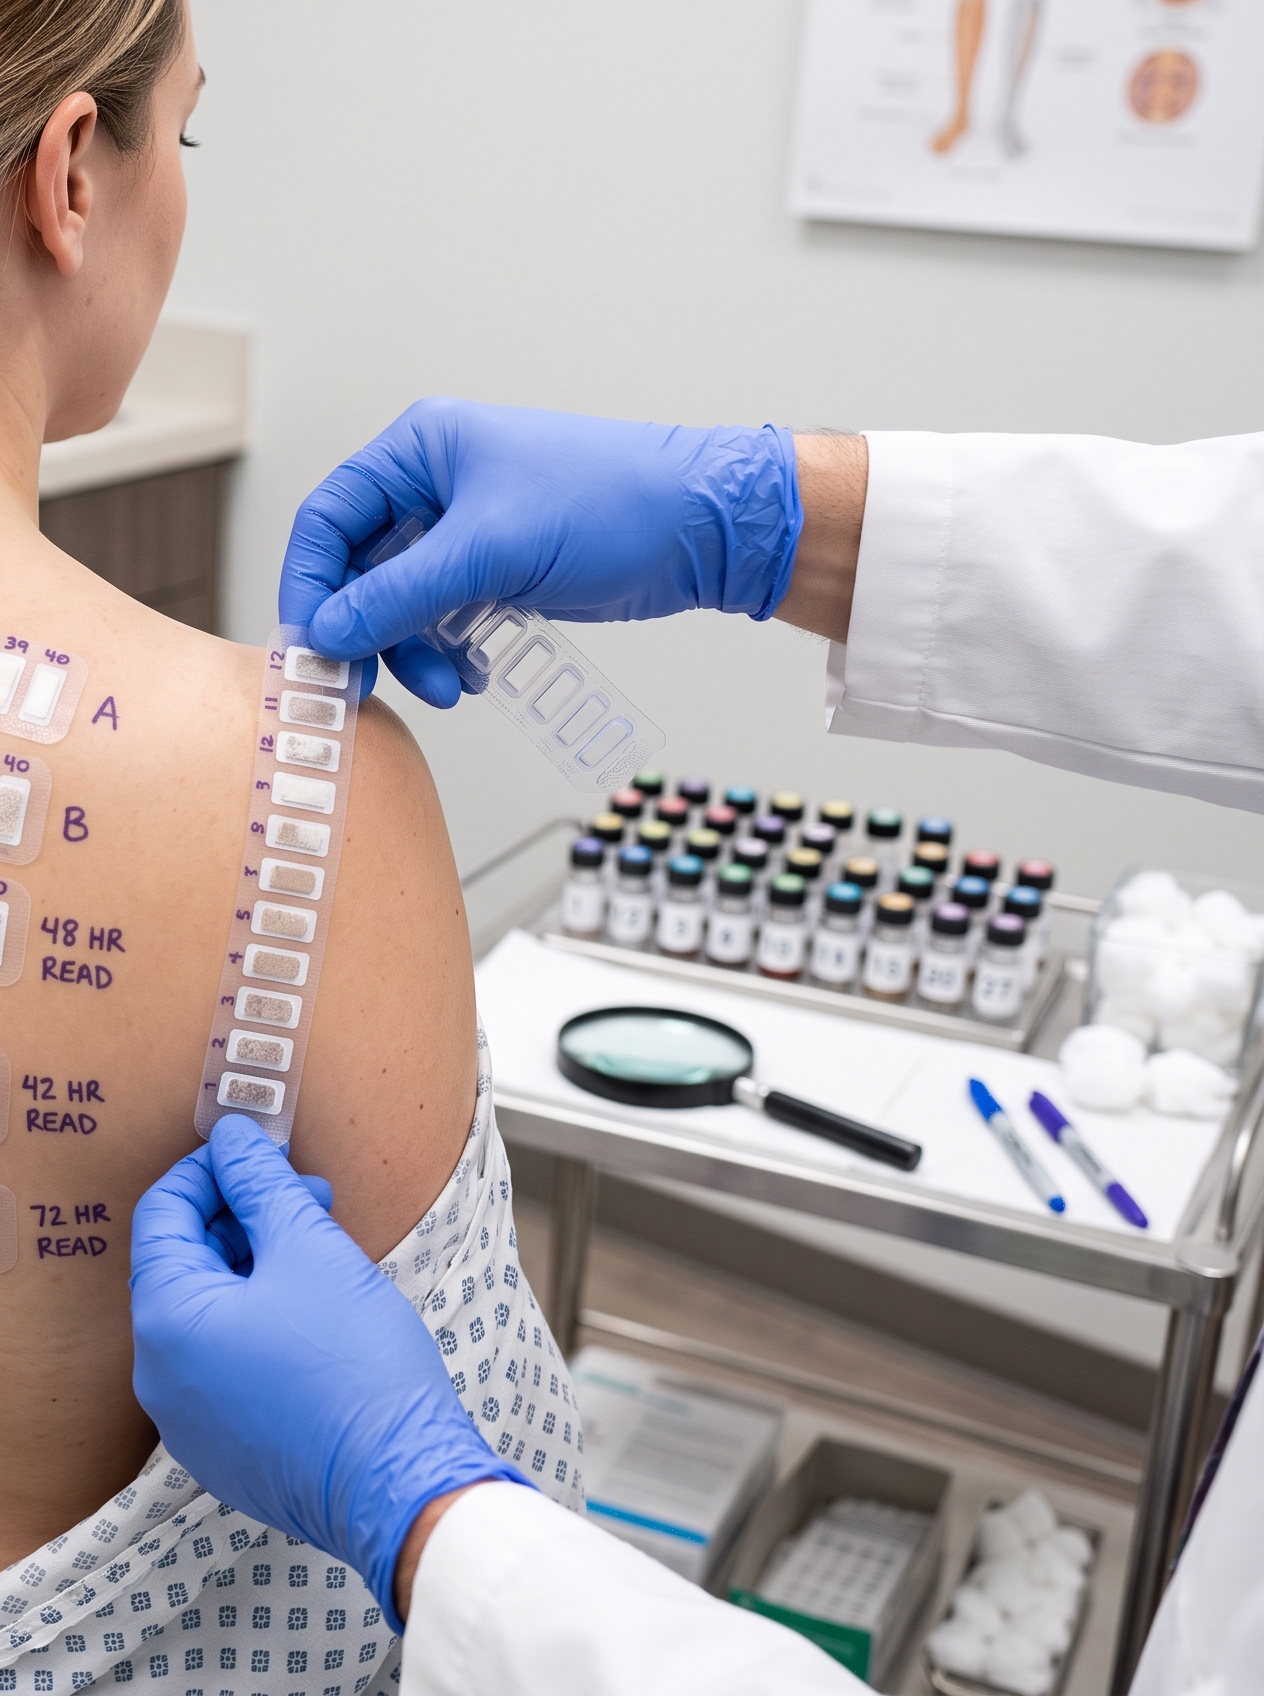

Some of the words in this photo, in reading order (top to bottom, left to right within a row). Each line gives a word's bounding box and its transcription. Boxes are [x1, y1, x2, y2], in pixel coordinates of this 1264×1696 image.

[4, 635, 30, 654] 39
[44, 648, 71, 666] 40
[269, 648, 285, 671] 12
[91, 695, 119, 731] A
[264, 696, 278, 711] 11
[259, 734, 274, 753] 12
[3, 754, 31, 774] 40
[62, 805, 89, 843] B
[40, 916, 80, 948] 48
[88, 926, 126, 953] HR
[41, 955, 113, 990] READ
[220, 995, 235, 1006] 3
[211, 1037, 227, 1049] 2
[21, 1074, 57, 1101] 42
[67, 1079, 106, 1103] HR
[26, 1107, 98, 1136] READ
[29, 1204, 68, 1228] 72
[74, 1202, 111, 1225] HR
[37, 1235, 108, 1259] READ
